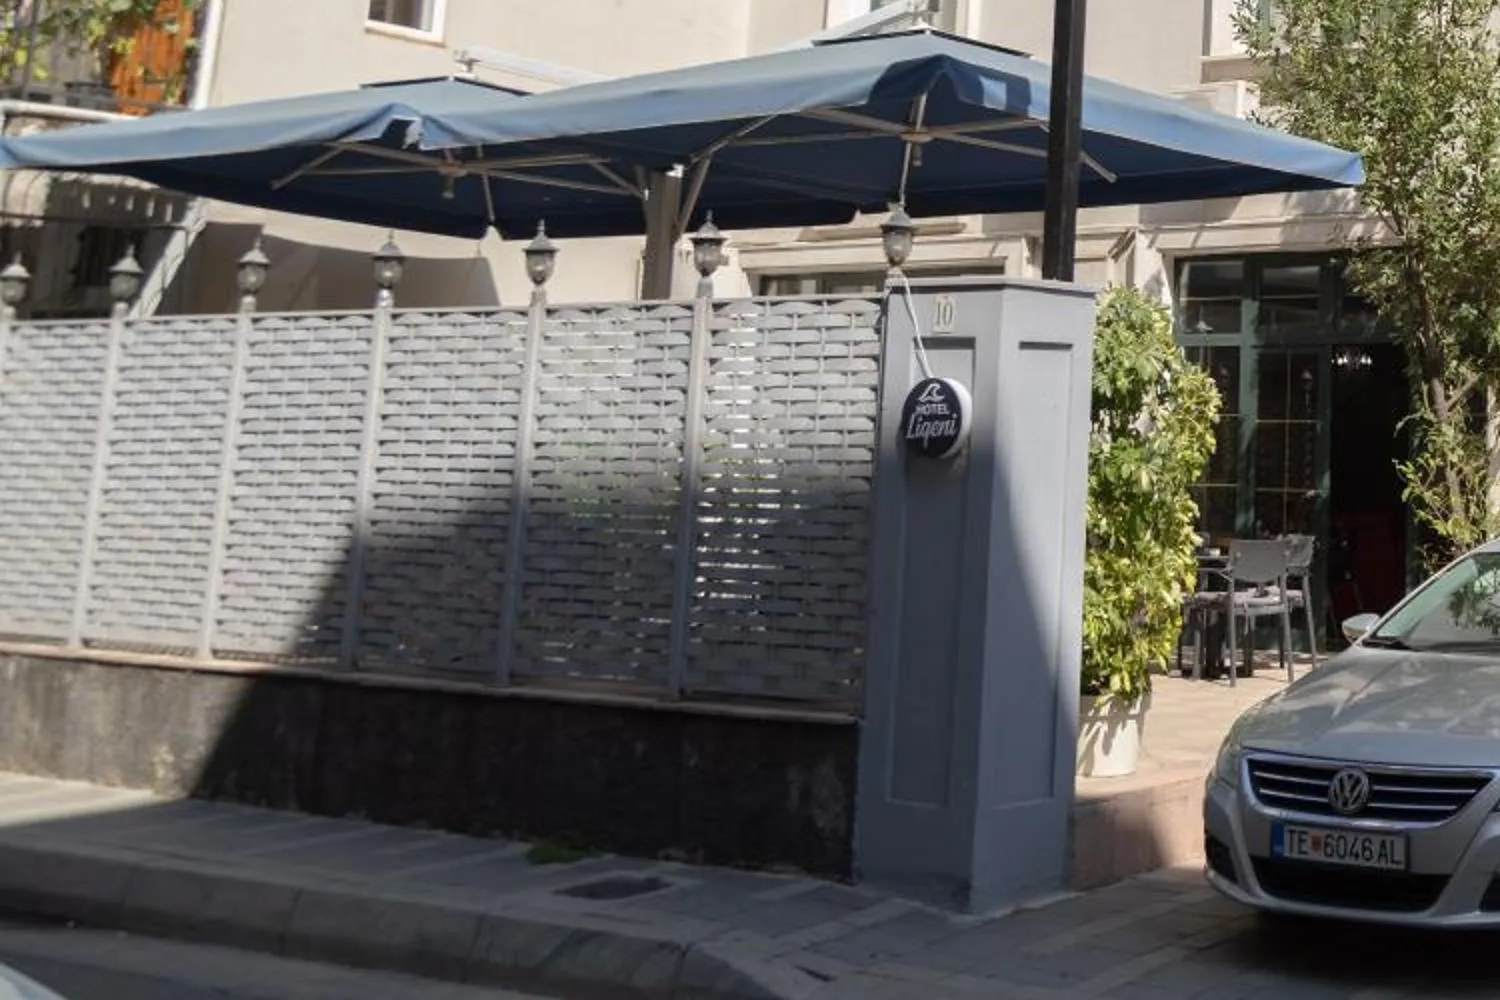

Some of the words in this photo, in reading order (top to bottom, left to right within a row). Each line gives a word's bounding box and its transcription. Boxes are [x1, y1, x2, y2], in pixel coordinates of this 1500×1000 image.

[936, 300, 953, 327] 10
[915, 403, 950, 415] HOTEL
[1288, 828, 1309, 856] TE
[1323, 832, 1374, 862] 6046
[1378, 839, 1403, 866] AL
